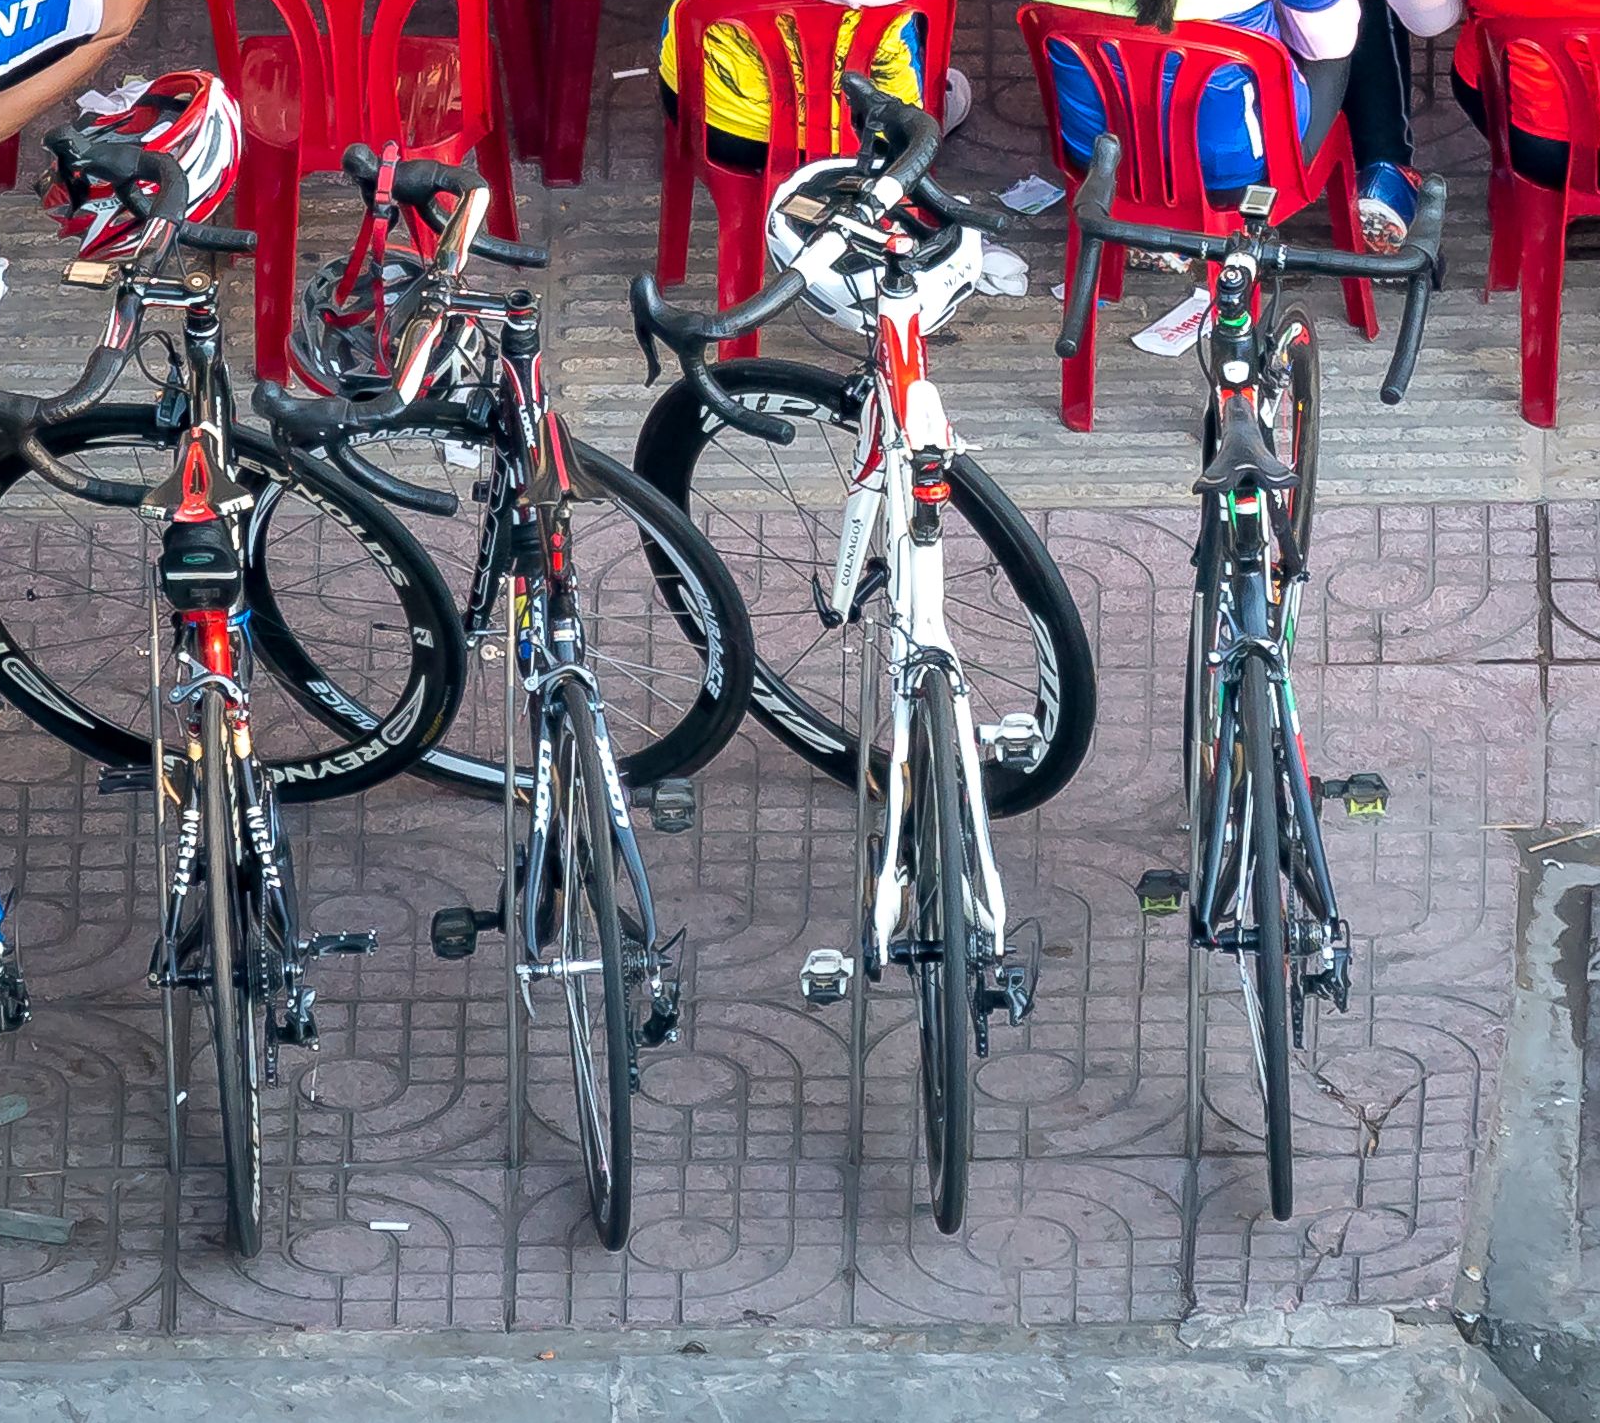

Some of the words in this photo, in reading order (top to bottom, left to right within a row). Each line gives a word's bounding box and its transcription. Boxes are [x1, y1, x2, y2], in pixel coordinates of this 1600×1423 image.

[518, 405, 537, 448] LOOK
[840, 524, 861, 588] COLNAGO
[534, 738, 552, 839] LOOK
[594, 734, 631, 830] LOOK
